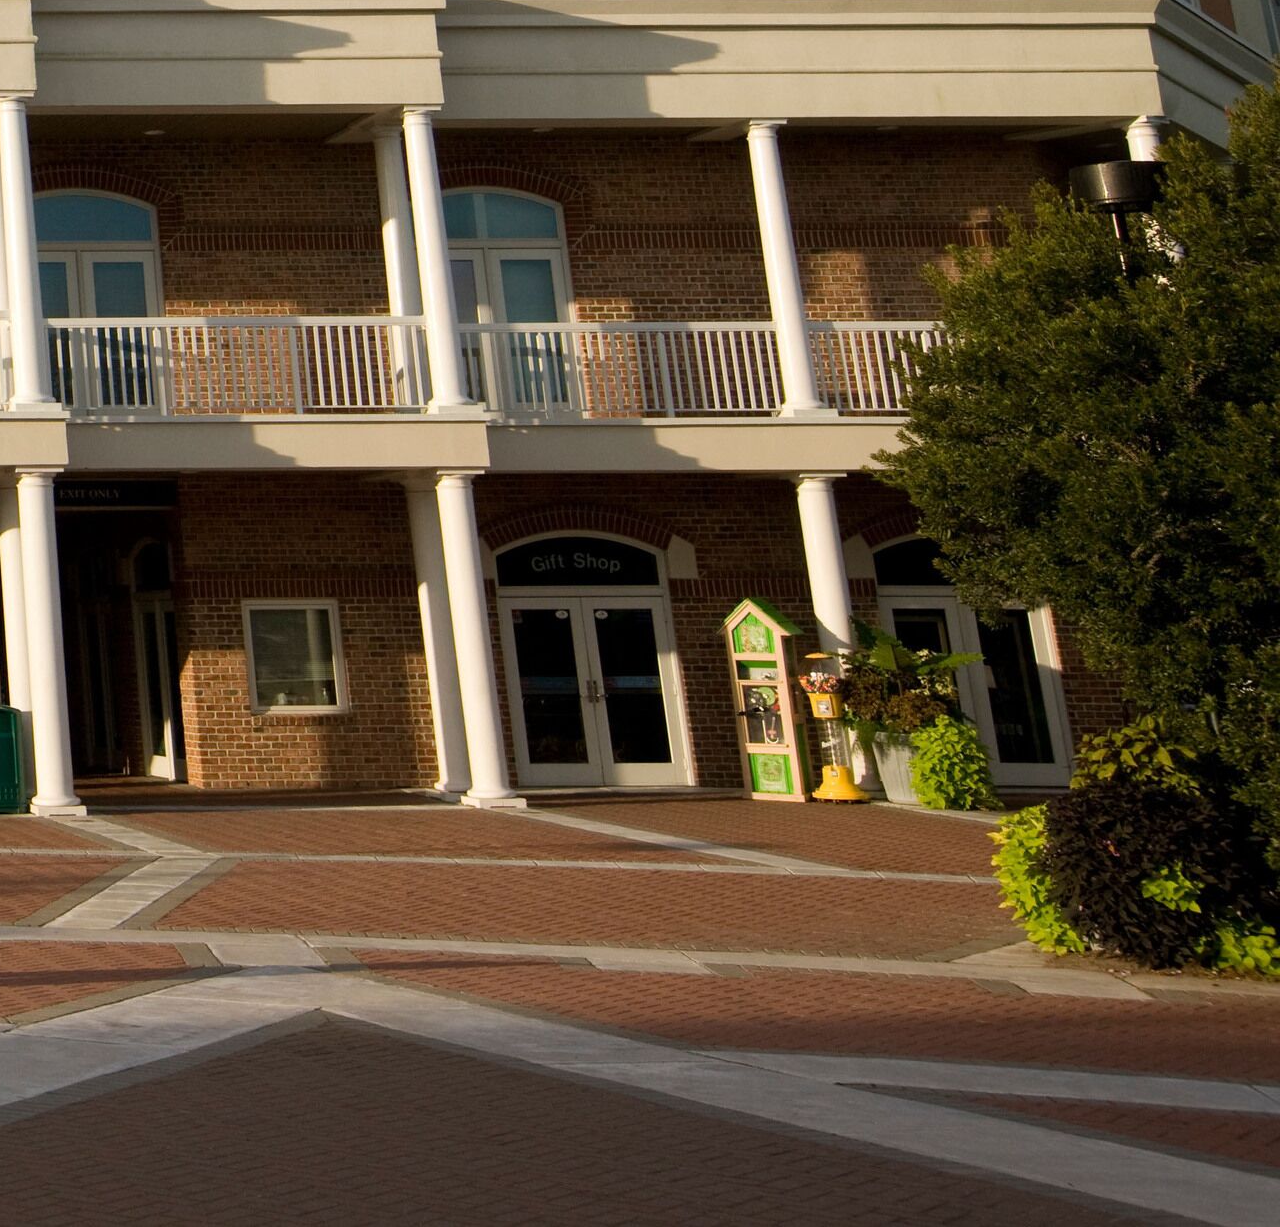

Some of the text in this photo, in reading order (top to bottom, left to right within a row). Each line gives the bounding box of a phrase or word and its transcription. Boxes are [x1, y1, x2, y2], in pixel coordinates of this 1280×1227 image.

[60, 489, 119, 498] EXIT ONLY
[531, 552, 621, 573] Gift Shop
